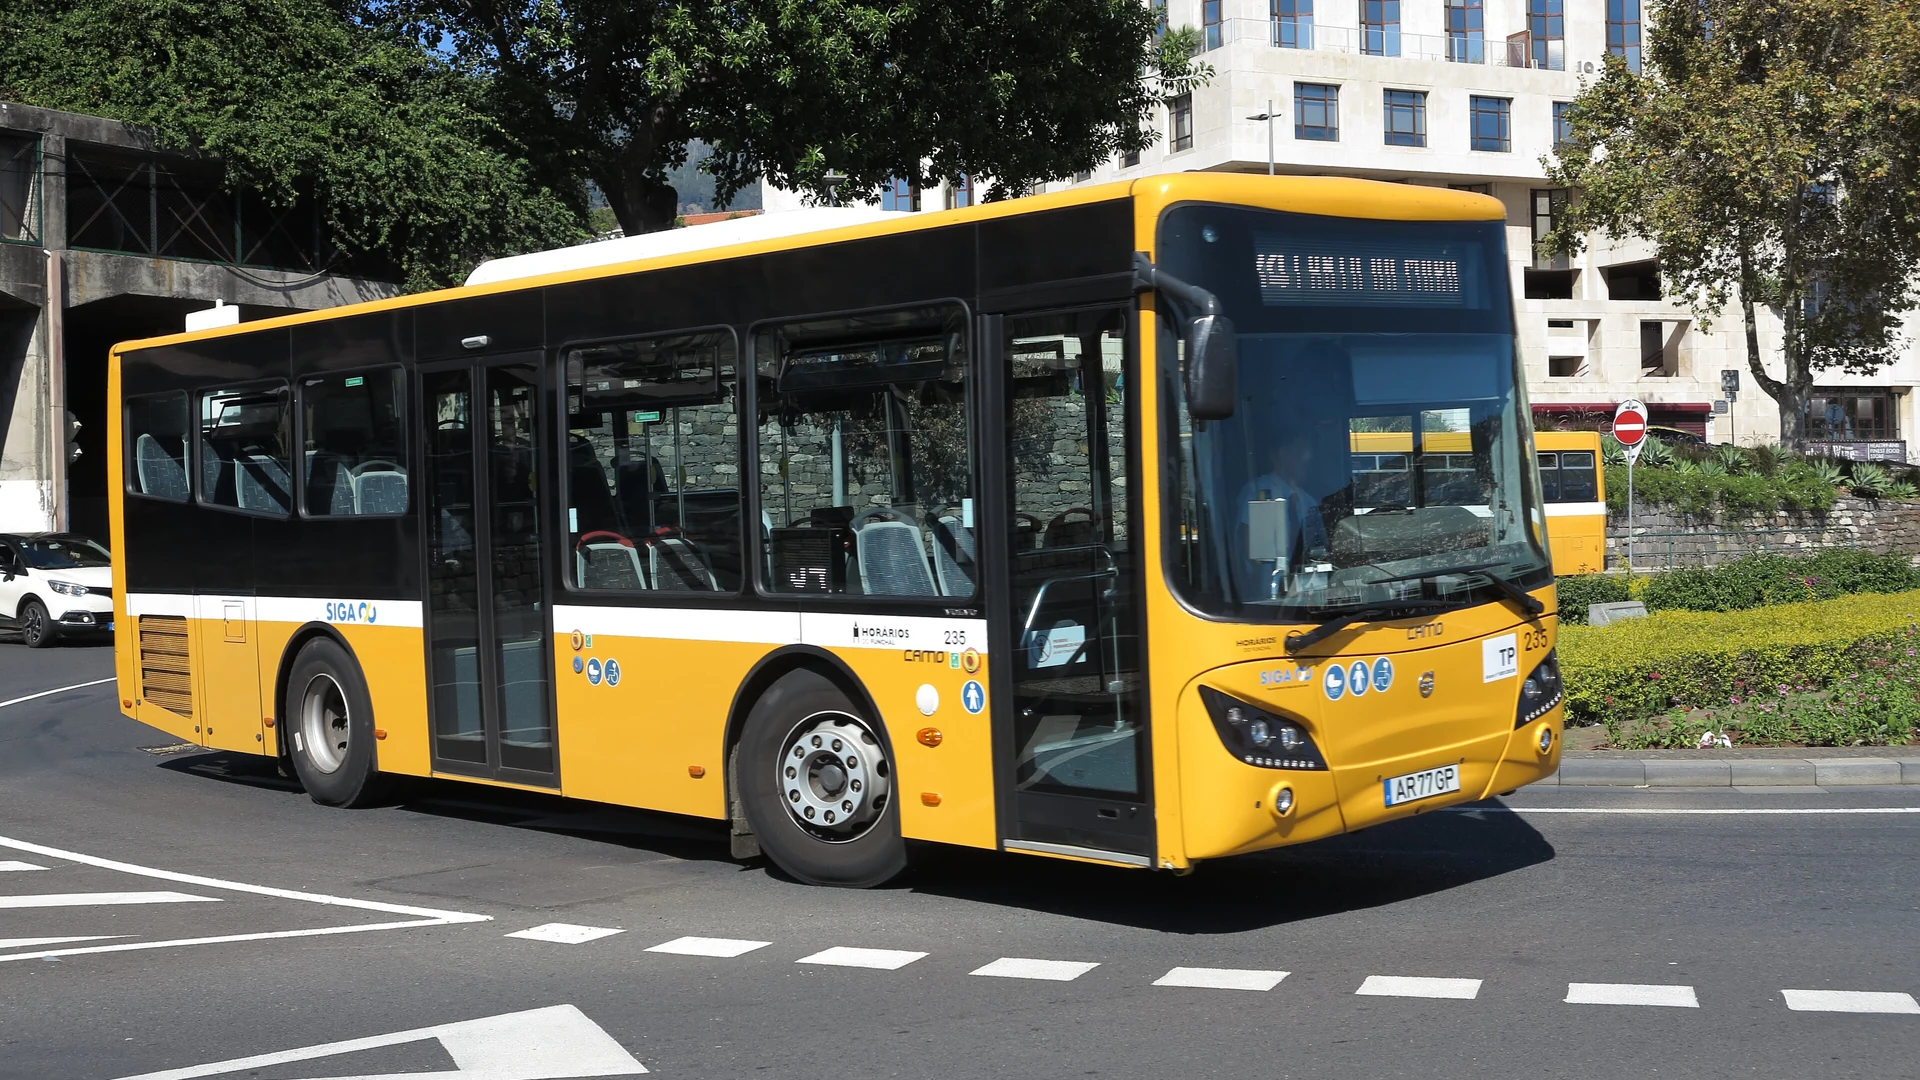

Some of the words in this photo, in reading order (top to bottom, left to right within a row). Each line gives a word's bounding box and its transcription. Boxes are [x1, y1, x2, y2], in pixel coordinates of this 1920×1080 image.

[326, 602, 356, 621] SIGA
[861, 625, 910, 639] HORÁRIOS
[943, 630, 967, 645] 235
[1523, 628, 1549, 652] 235
[1498, 646, 1516, 667] TP
[1260, 669, 1292, 685] SIGA
[1396, 767, 1454, 801] AR77GP
